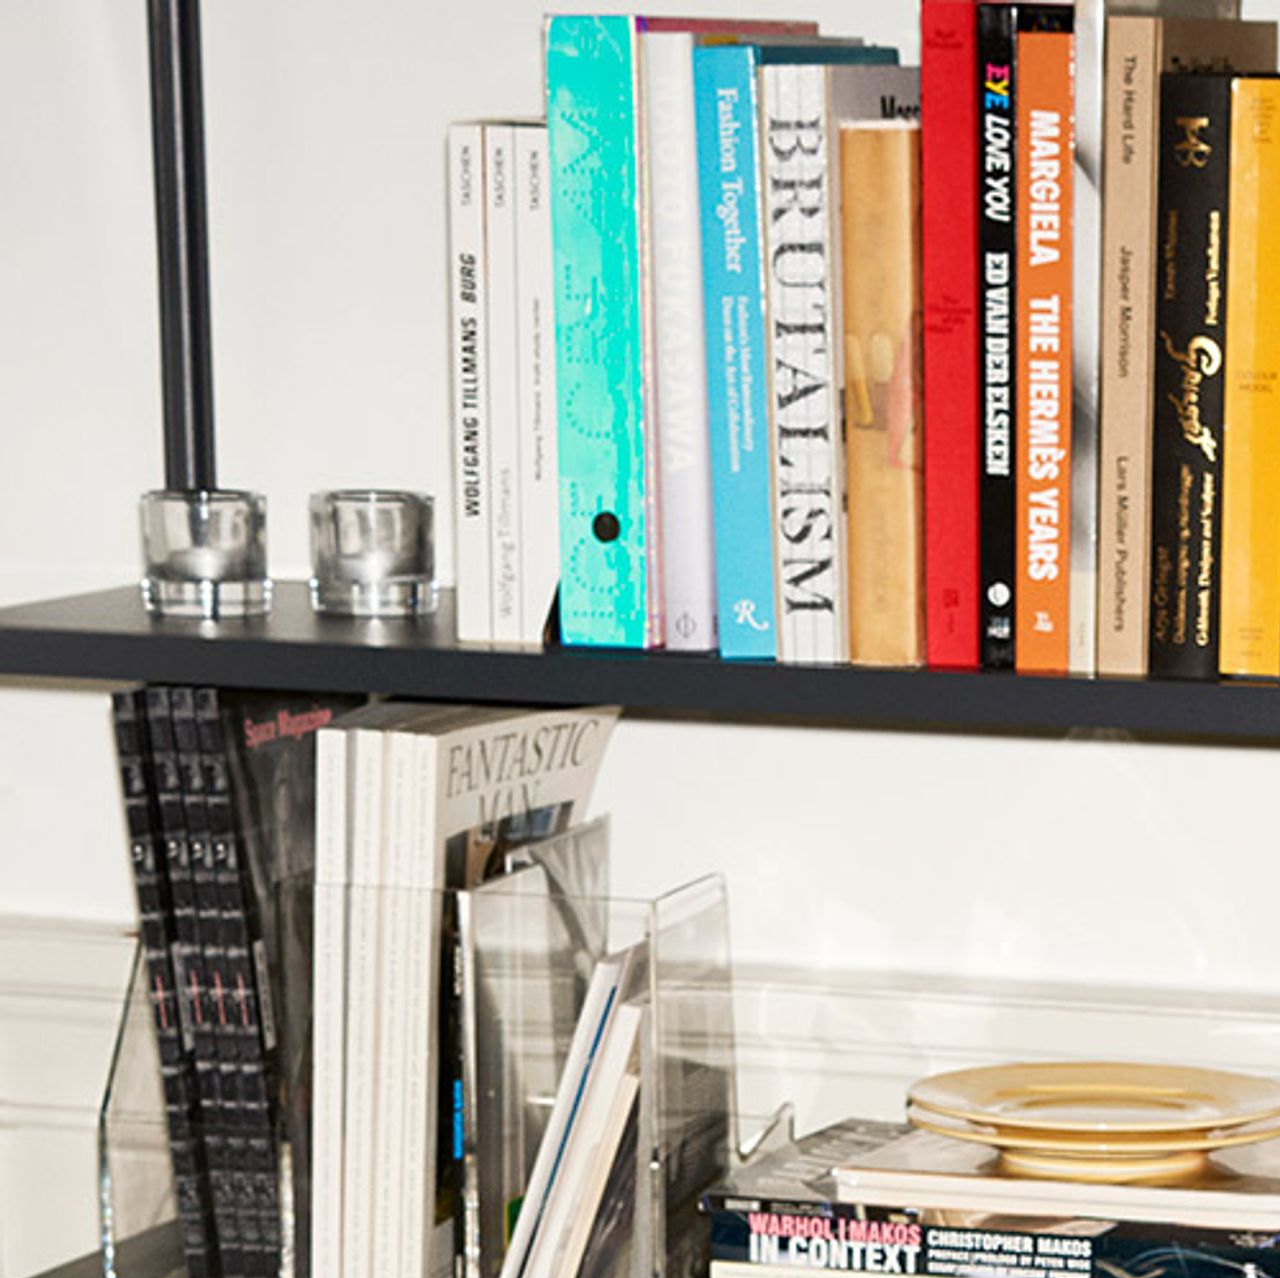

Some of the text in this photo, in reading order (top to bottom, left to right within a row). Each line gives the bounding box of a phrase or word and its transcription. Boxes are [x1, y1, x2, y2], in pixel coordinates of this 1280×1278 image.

[985, 64, 1011, 223] EYE LOVE YOU
[1120, 55, 1140, 166] The Hard Life
[460, 146, 472, 205] TASCHEN
[493, 147, 505, 207] TASCHEN
[529, 150, 541, 209] TASCHEN
[716, 88, 748, 274] Fashion Together
[1029, 109, 1061, 266] MARGIELA
[1028, 294, 1060, 359] THE
[1115, 245, 1136, 379] Jasper Morrison
[459, 252, 481, 517] WOLFGANG TILLMANS BURG
[769, 116, 835, 615] BRUTALISM
[985, 252, 1009, 477] ED VAN DER ELSKEN
[1028, 361, 1067, 480] HERMÈS
[1115, 455, 1131, 491] Lars
[1028, 488, 1059, 581] YEARS
[1112, 549, 1131, 633] Publishers
[446, 719, 600, 800] FANTASTIC
[748, 1212, 836, 1241] WARHOL
[849, 1221, 922, 1246] MAKOS
[749, 1233, 780, 1262] IN
[787, 1236, 921, 1274] CONTEXT
[926, 1230, 1092, 1257] CHRISTOPHER MAKOS
